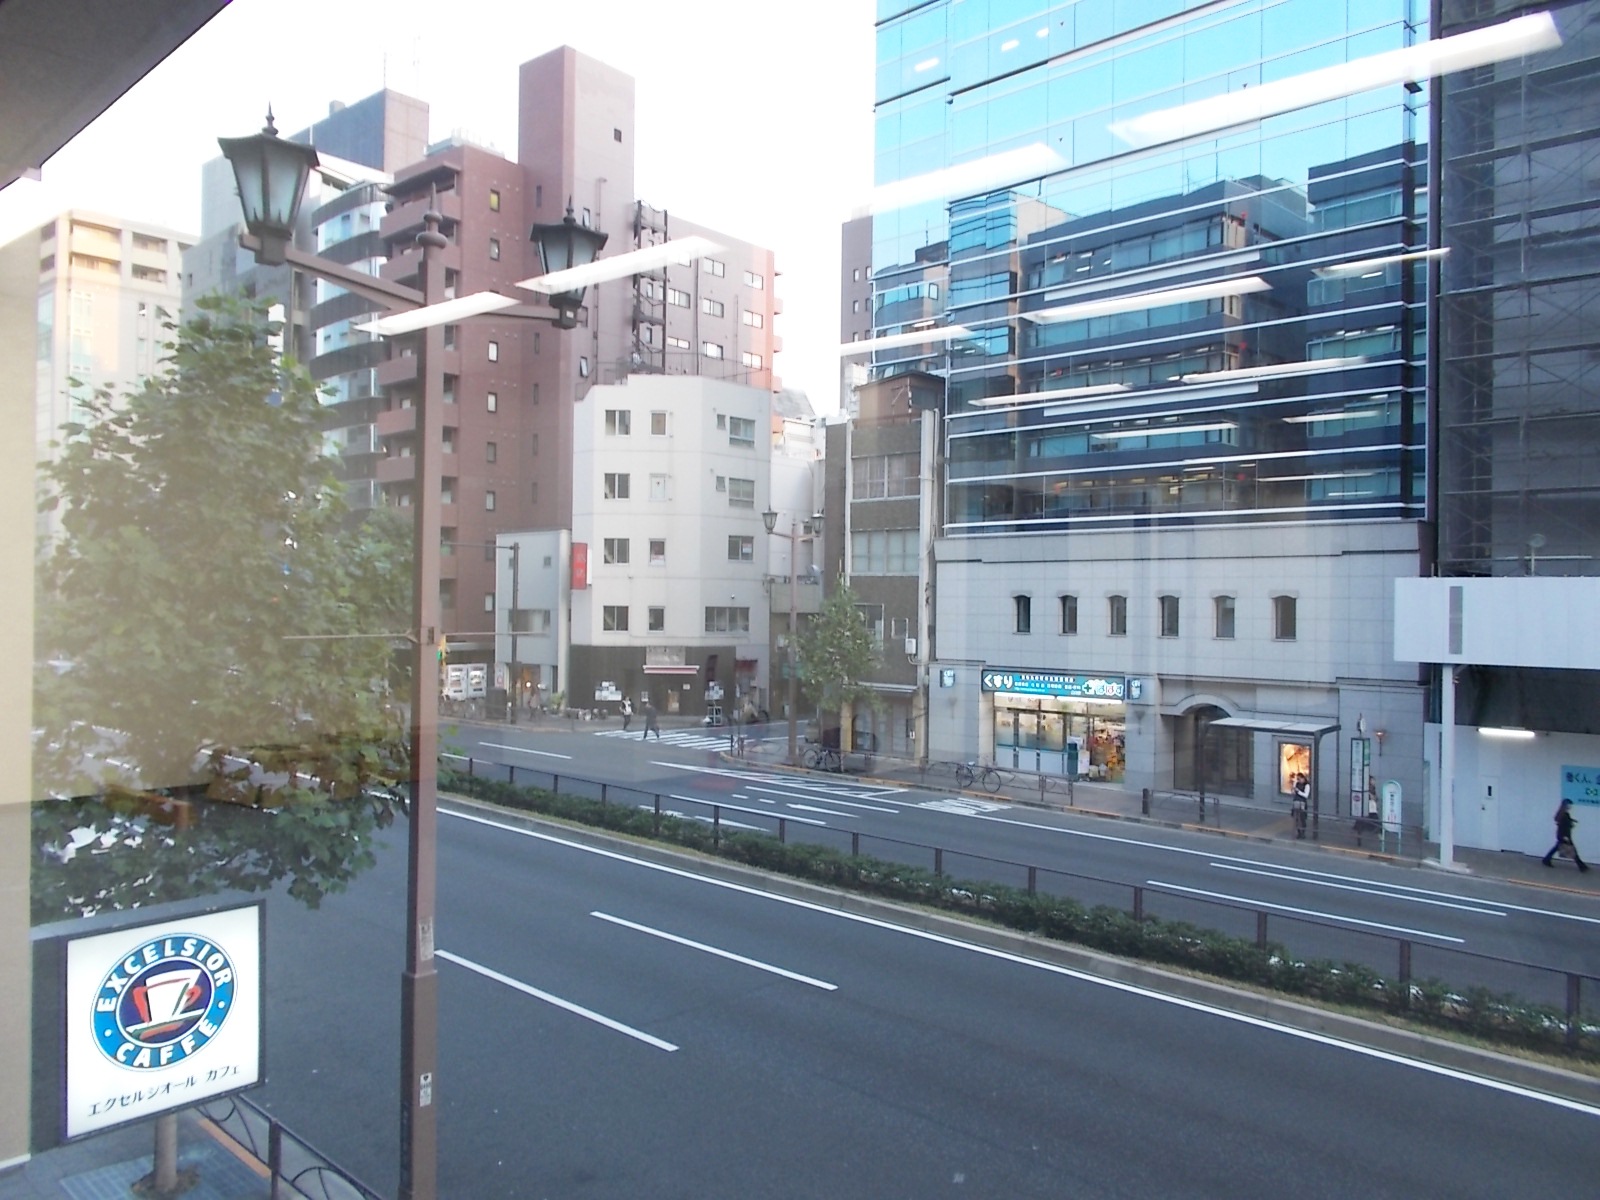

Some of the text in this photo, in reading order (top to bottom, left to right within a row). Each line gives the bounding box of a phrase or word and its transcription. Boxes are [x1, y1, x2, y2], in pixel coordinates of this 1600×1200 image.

[983, 674, 1013, 689] くすり
[97, 937, 232, 1012] EXCELSIOR
[88, 1065, 240, 1116] エクセルシオール カフェ
